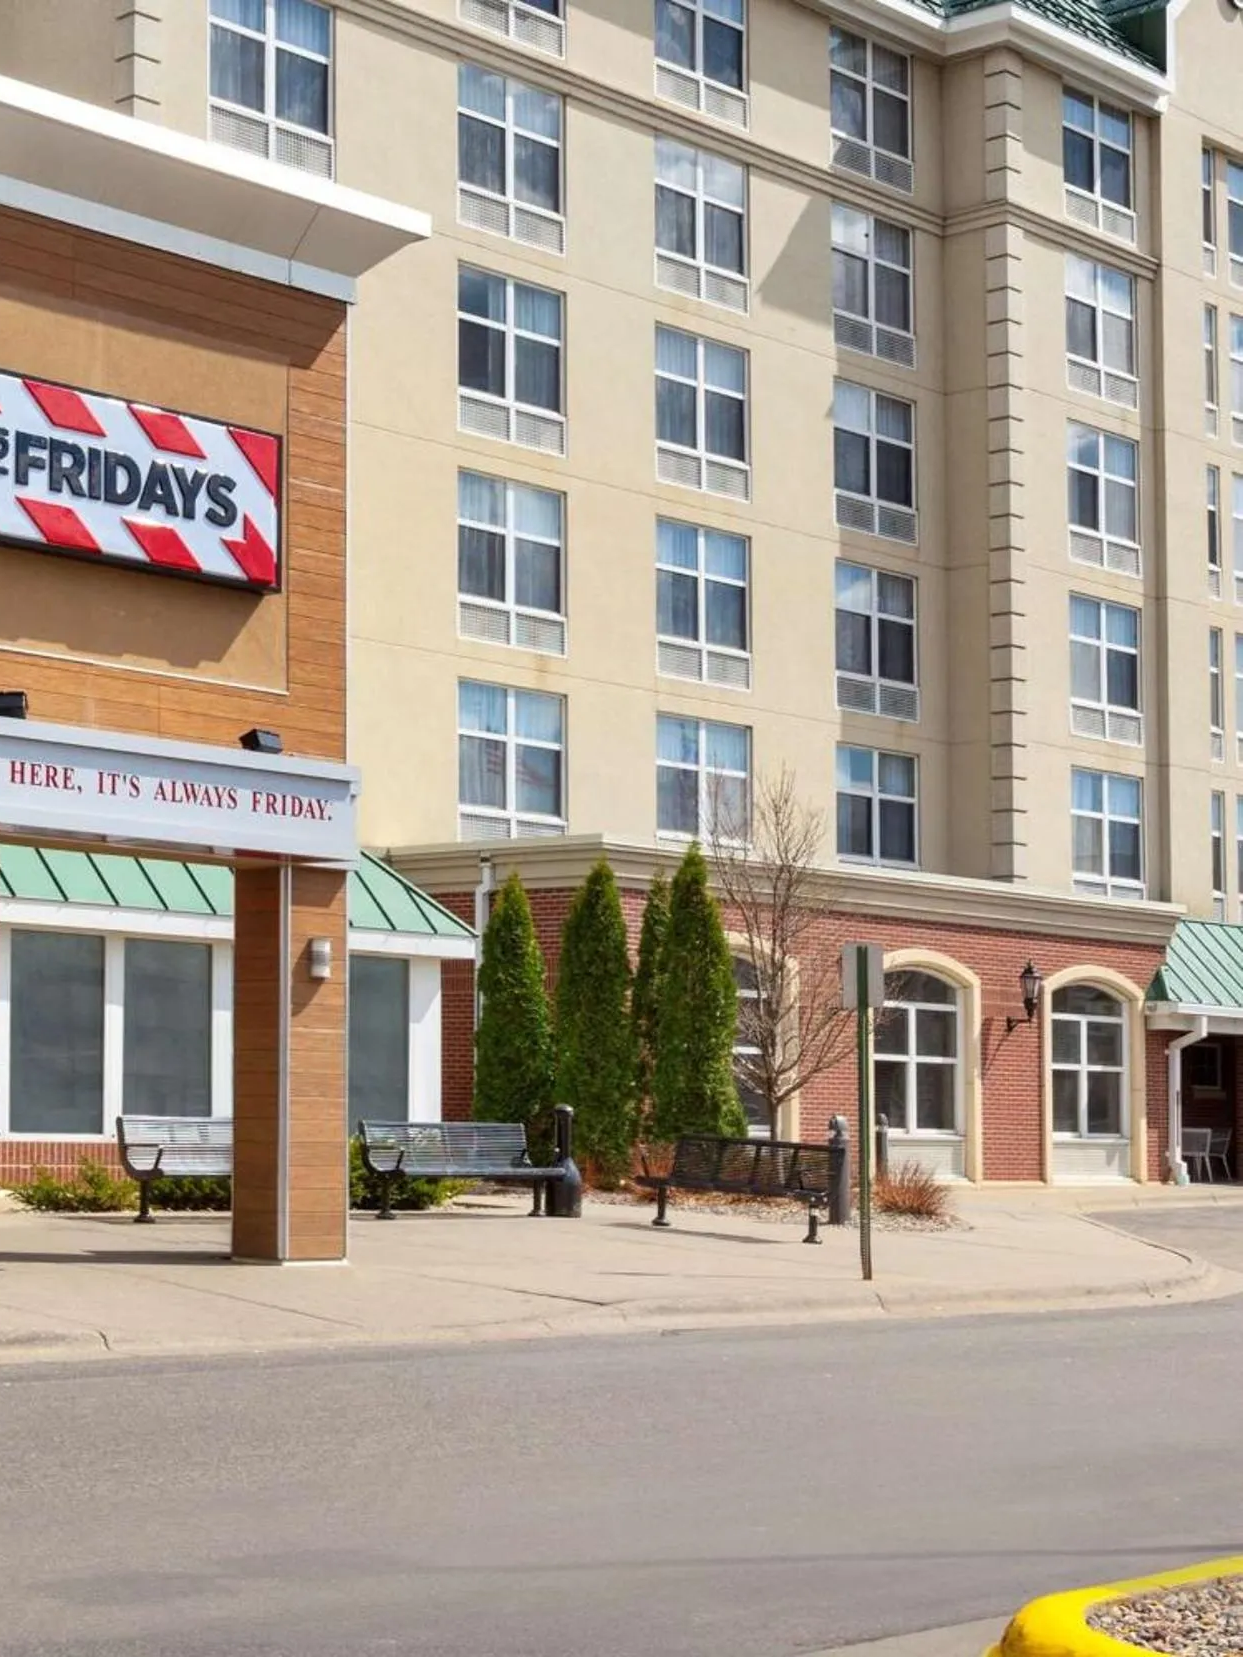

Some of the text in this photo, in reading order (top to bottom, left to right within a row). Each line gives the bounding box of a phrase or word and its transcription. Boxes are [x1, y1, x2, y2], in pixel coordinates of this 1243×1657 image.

[14, 430, 238, 528] FRIDAYS
[10, 760, 83, 793] HERE,
[98, 771, 141, 798] IT'S
[154, 782, 239, 810] ALWAYS
[252, 791, 334, 821] FRIDAY.
